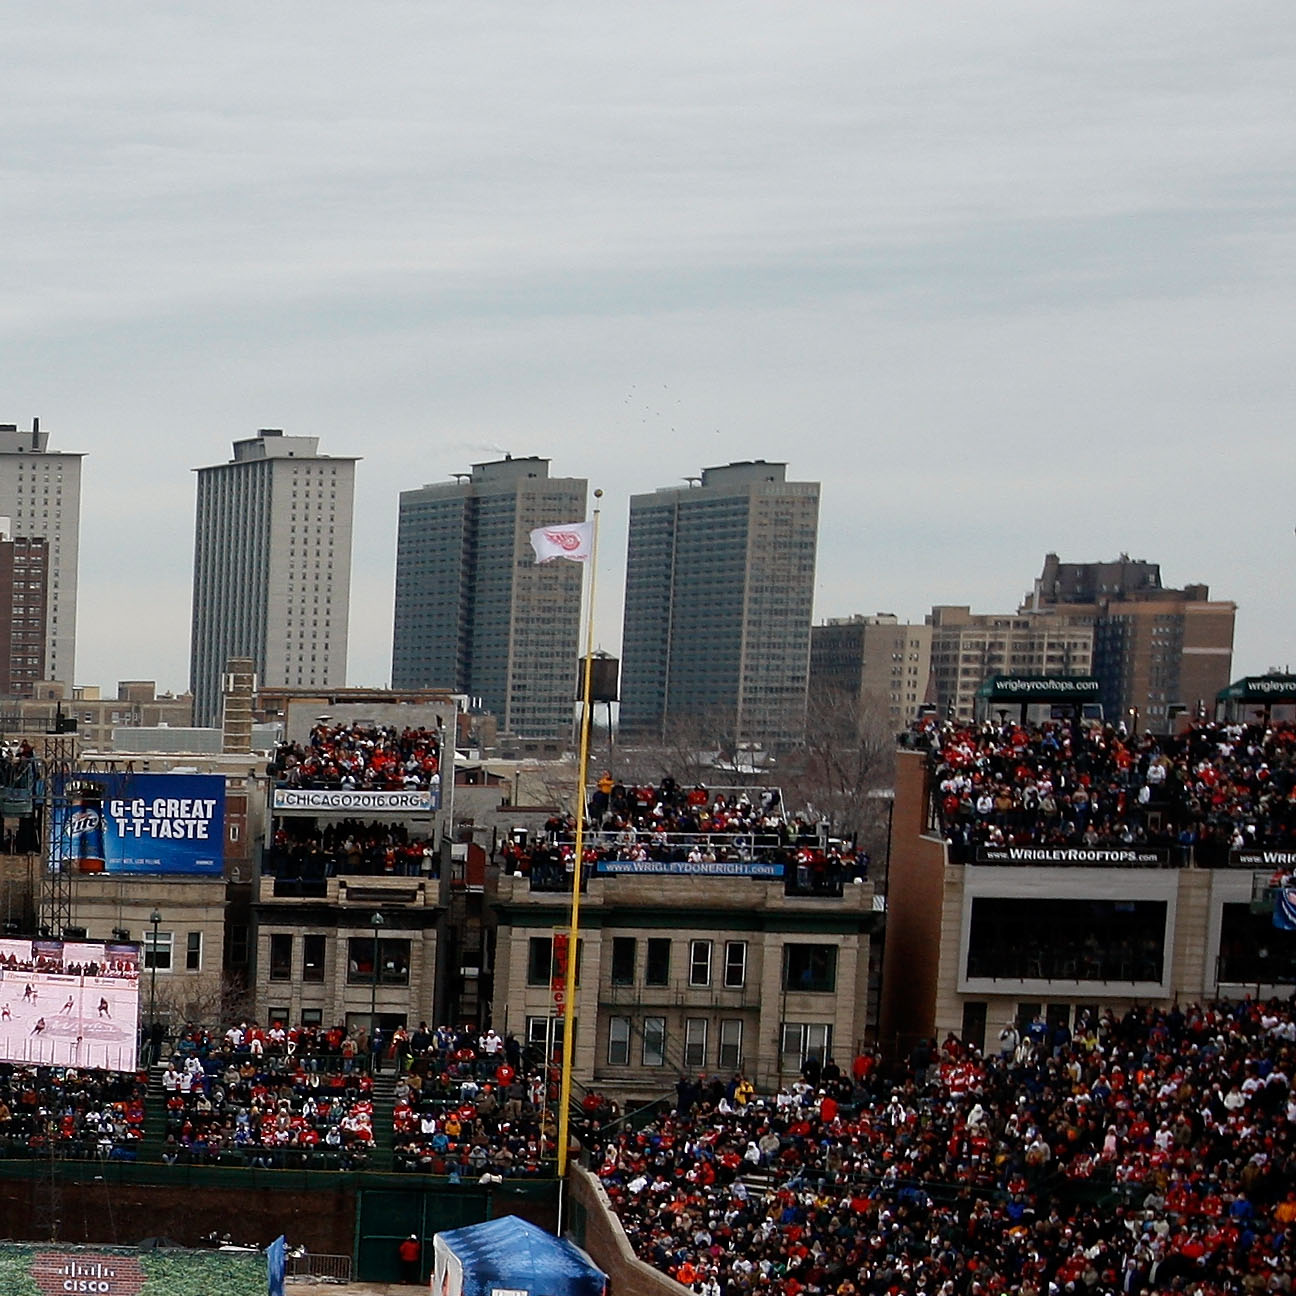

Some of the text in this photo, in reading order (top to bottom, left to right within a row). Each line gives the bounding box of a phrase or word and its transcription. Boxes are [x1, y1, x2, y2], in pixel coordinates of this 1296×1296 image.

[995, 679, 1099, 692] wrigleyrooftops.com
[286, 792, 420, 807] CHICAGO2016.ORG
[110, 798, 216, 818] G-G-GREAT
[116, 818, 209, 840] T-T-TASTE
[986, 848, 1158, 862] www.WRIGLEYROOFTOPS.com
[64, 1280, 110, 1292] CISCO
